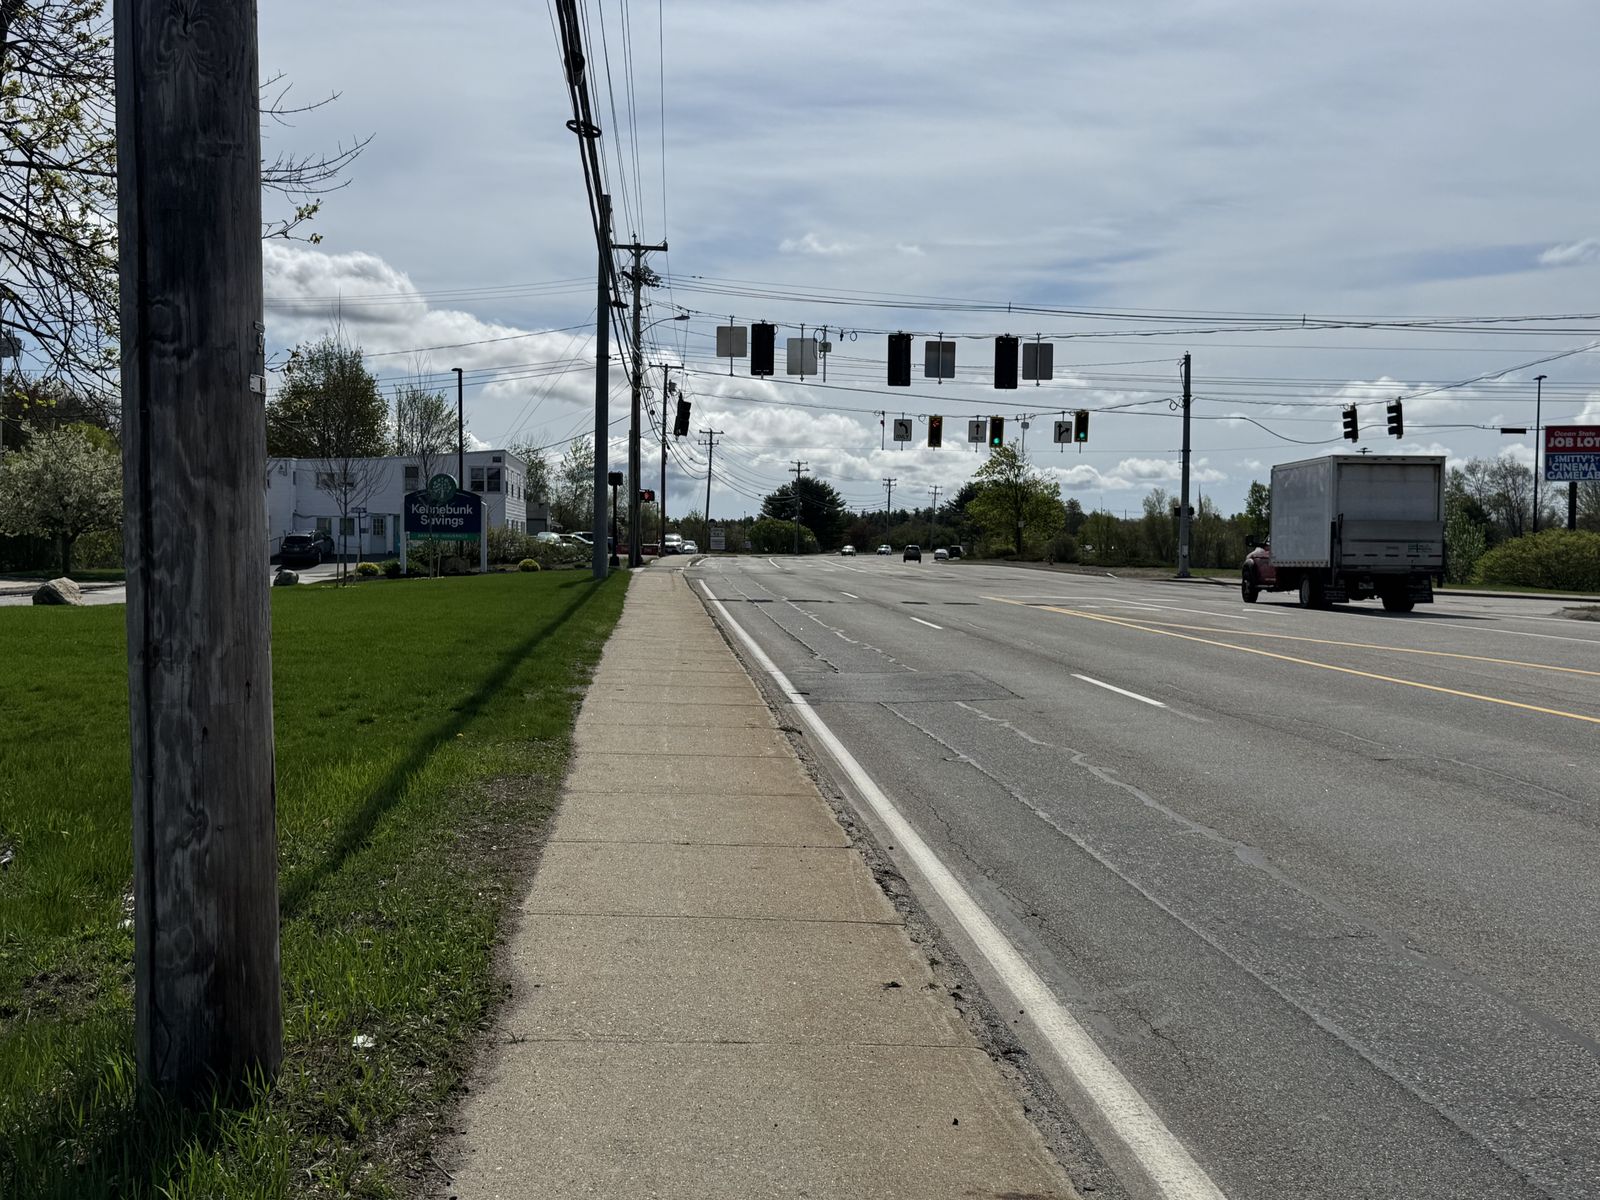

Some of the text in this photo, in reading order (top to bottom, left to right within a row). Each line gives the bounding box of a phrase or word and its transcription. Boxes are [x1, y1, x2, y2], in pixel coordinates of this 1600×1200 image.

[1548, 437, 1600, 447] JOB LOT
[1551, 463, 1597, 471] CINEMA
[1547, 471, 1600, 480] GAMELAB
[411, 503, 473, 515] Kennebunk
[420, 515, 464, 528] Savings
